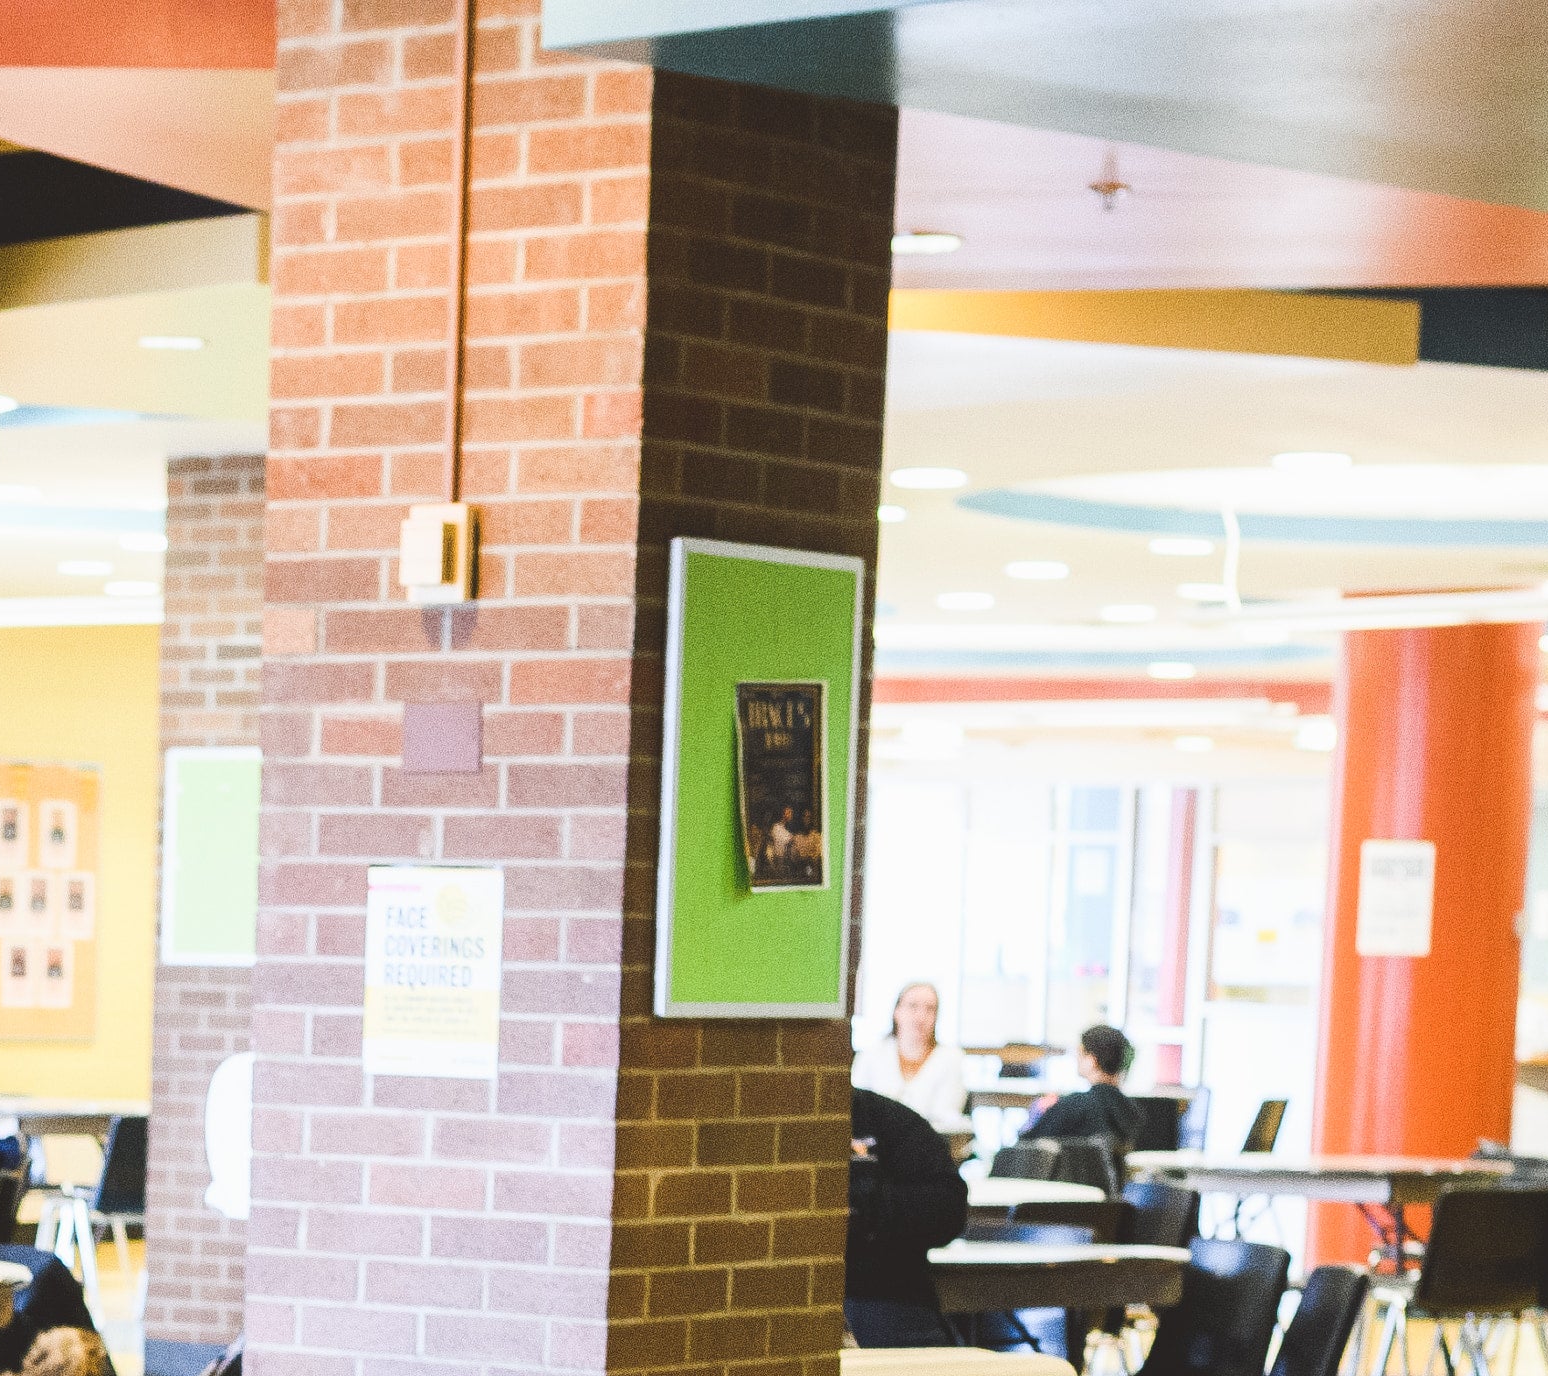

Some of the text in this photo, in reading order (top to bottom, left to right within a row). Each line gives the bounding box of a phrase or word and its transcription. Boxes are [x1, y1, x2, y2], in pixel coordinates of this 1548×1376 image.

[385, 906, 428, 928] FACE
[384, 935, 486, 959] COVERINGS
[383, 963, 473, 989] REQUIRED
